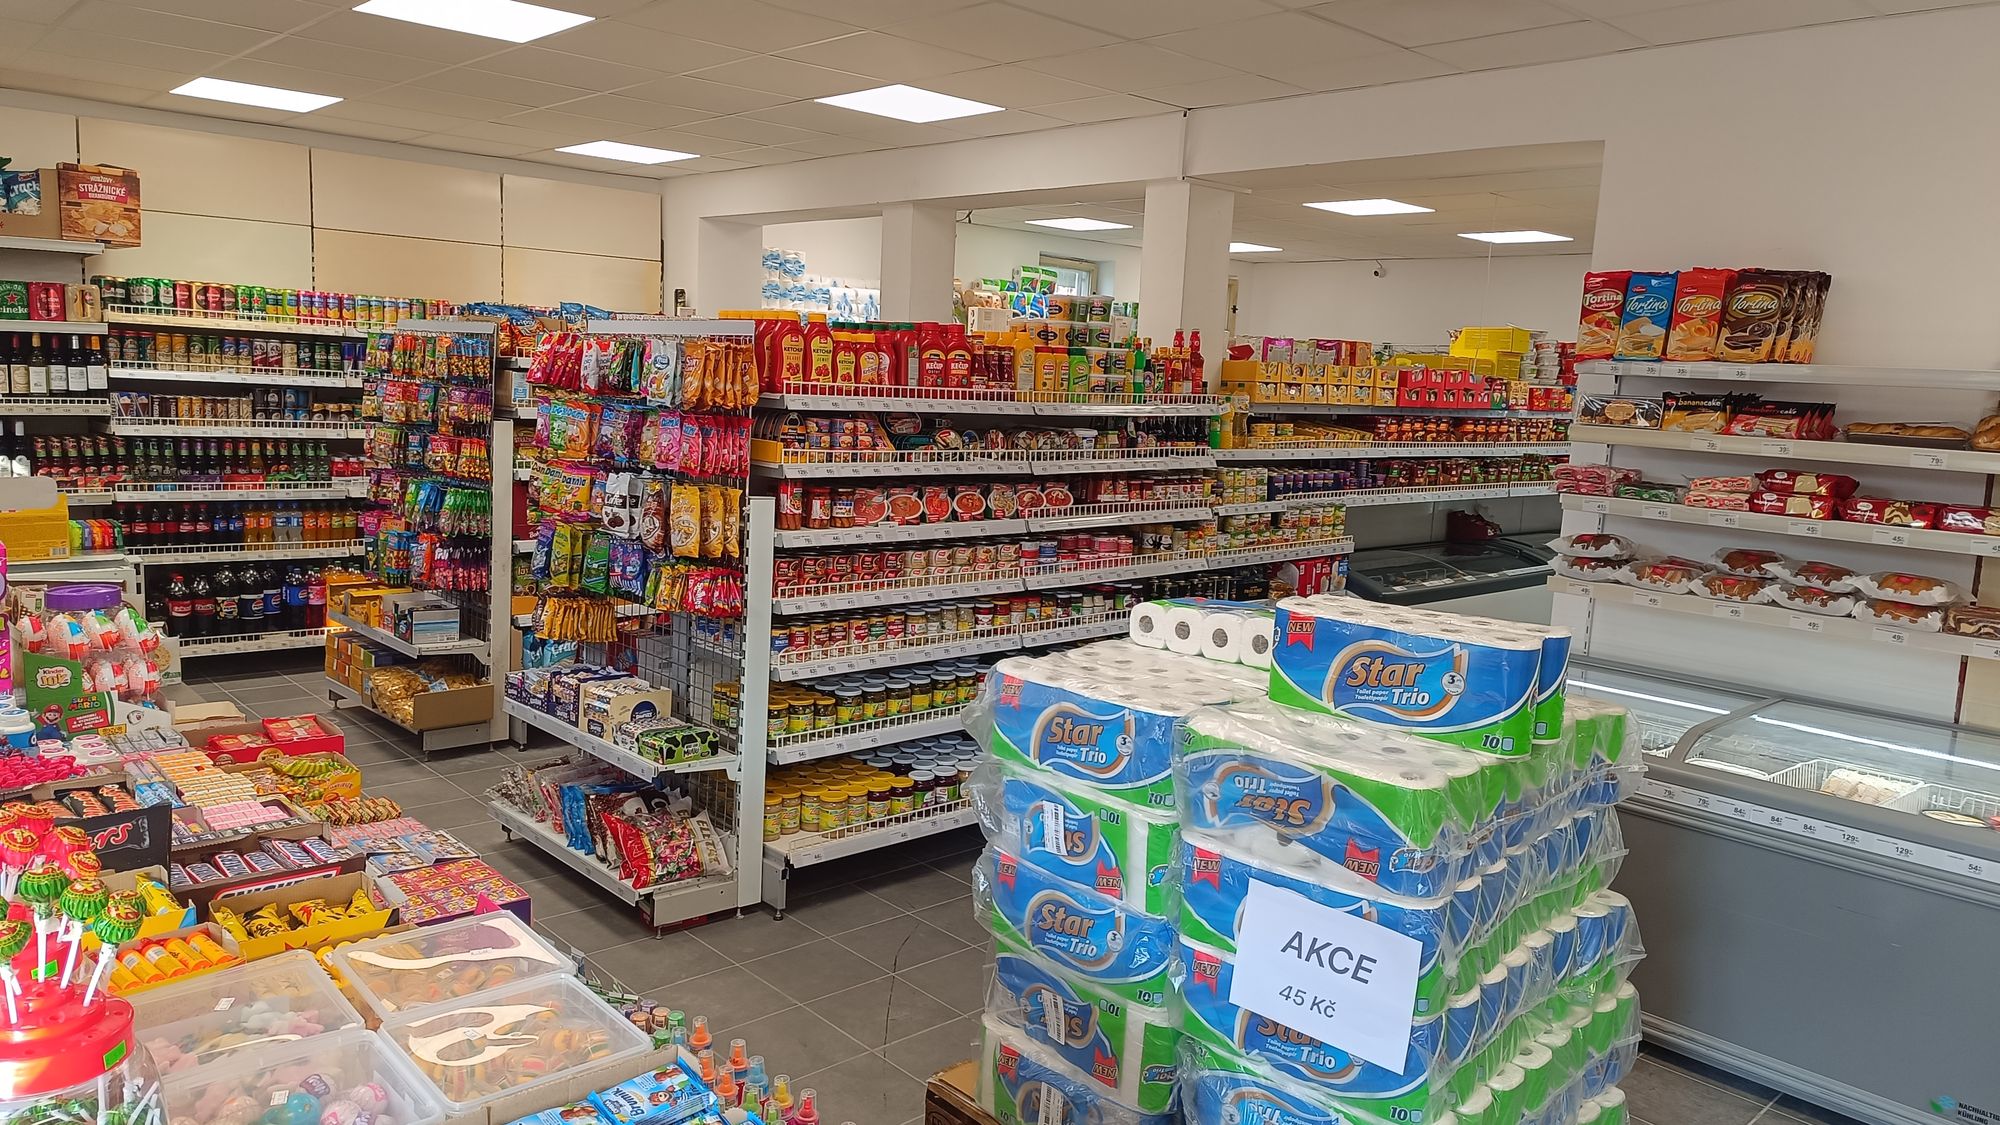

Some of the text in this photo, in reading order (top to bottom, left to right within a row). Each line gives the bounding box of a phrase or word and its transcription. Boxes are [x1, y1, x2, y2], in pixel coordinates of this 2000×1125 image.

[79, 183, 126, 197] STRÁŽNICKÉ
[1583, 292, 1622, 305] Tortina
[1626, 294, 1668, 312] Tortina
[1677, 295, 1721, 313] Tortina
[1732, 294, 1778, 311] Tortina
[1288, 620, 1316, 633] NEW
[1346, 656, 1426, 688] Star
[1001, 684, 1023, 697] NEW
[1391, 688, 1430, 706] Trio
[68, 702, 101, 711] MARIO
[1047, 717, 1104, 746] Star
[1482, 734, 1501, 749] 10
[1080, 747, 1107, 764] Trio
[1235, 775, 1267, 793] Trio
[1236, 793, 1311, 826] Star
[1108, 814, 1121, 825] 10
[999, 861, 1017, 876] NEW
[1193, 857, 1220, 872] NEW
[1344, 858, 1379, 876] NEW
[1096, 876, 1121, 889] NEW
[1038, 904, 1096, 938] Star
[1068, 938, 1098, 958] Trio
[1280, 931, 1377, 985] AKCE
[1193, 959, 1221, 978] NEW
[1137, 990, 1151, 1002] 10
[1278, 986, 1338, 1018] 45 Kč
[998, 1054, 1019, 1069] NEW
[1299, 1047, 1337, 1069] Trio
[1093, 1064, 1118, 1080] NEW
[1390, 1107, 1408, 1121] 10
[1957, 1110, 1989, 1125] KÜHLUNG
